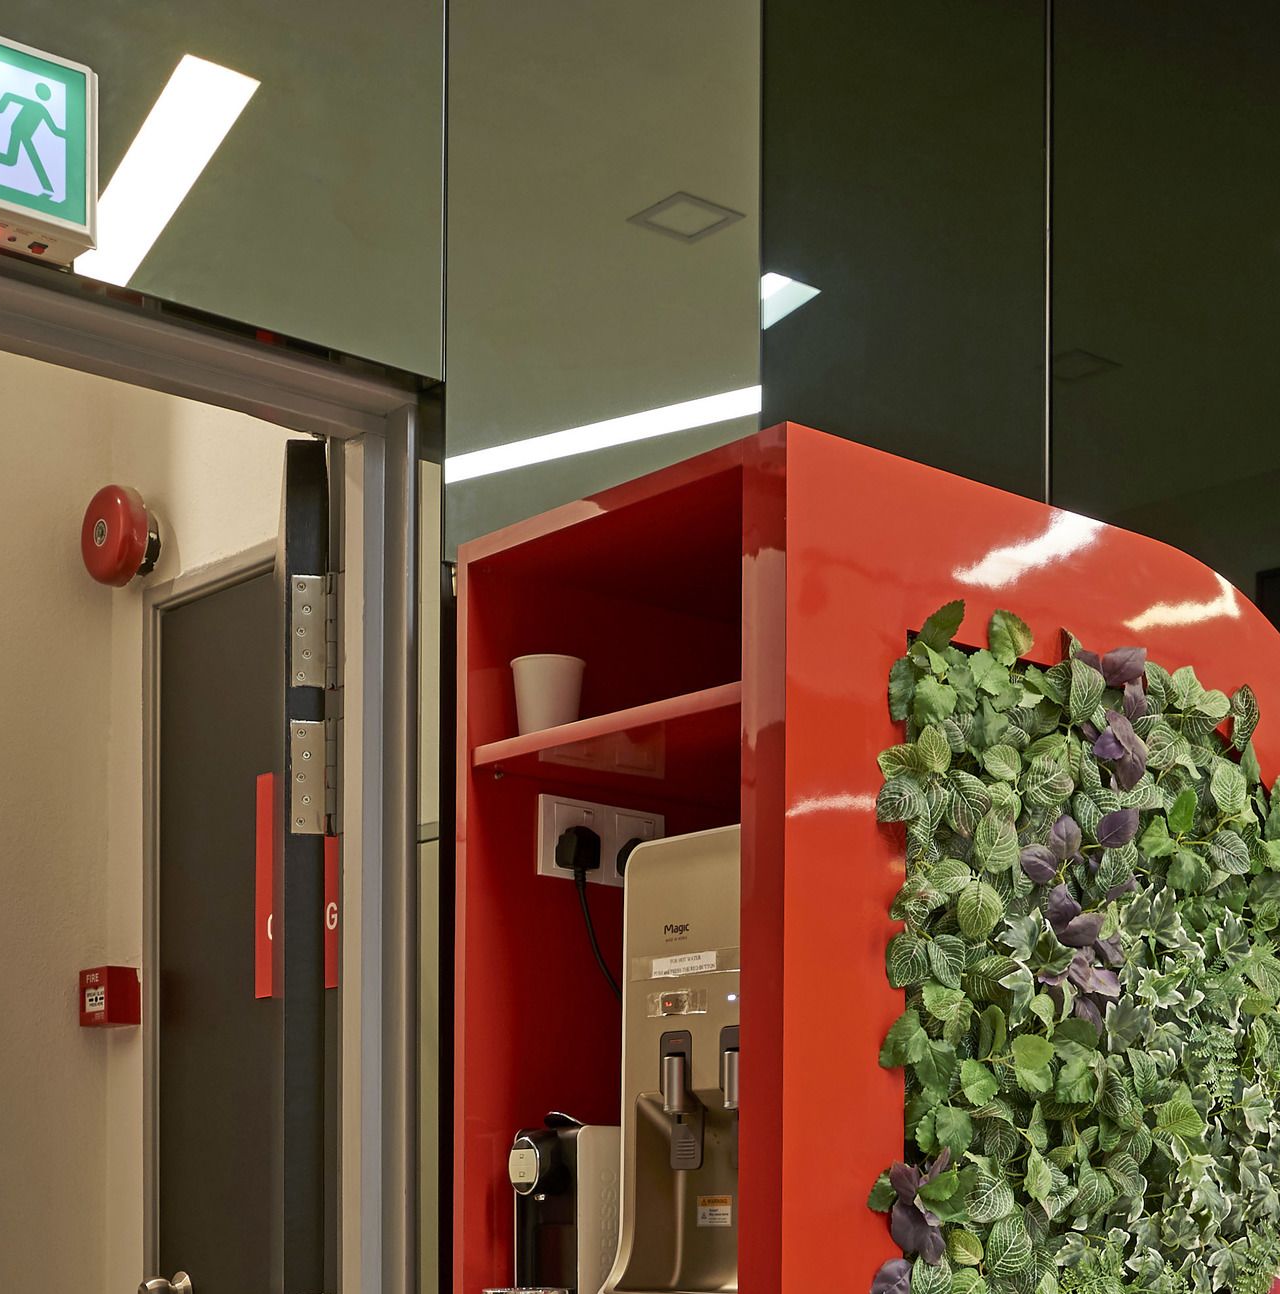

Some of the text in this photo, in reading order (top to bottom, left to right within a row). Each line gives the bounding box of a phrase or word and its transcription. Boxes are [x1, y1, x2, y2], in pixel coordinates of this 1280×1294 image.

[326, 902, 338, 930] G
[664, 923, 690, 935] Magic
[86, 973, 99, 984] FIRE
